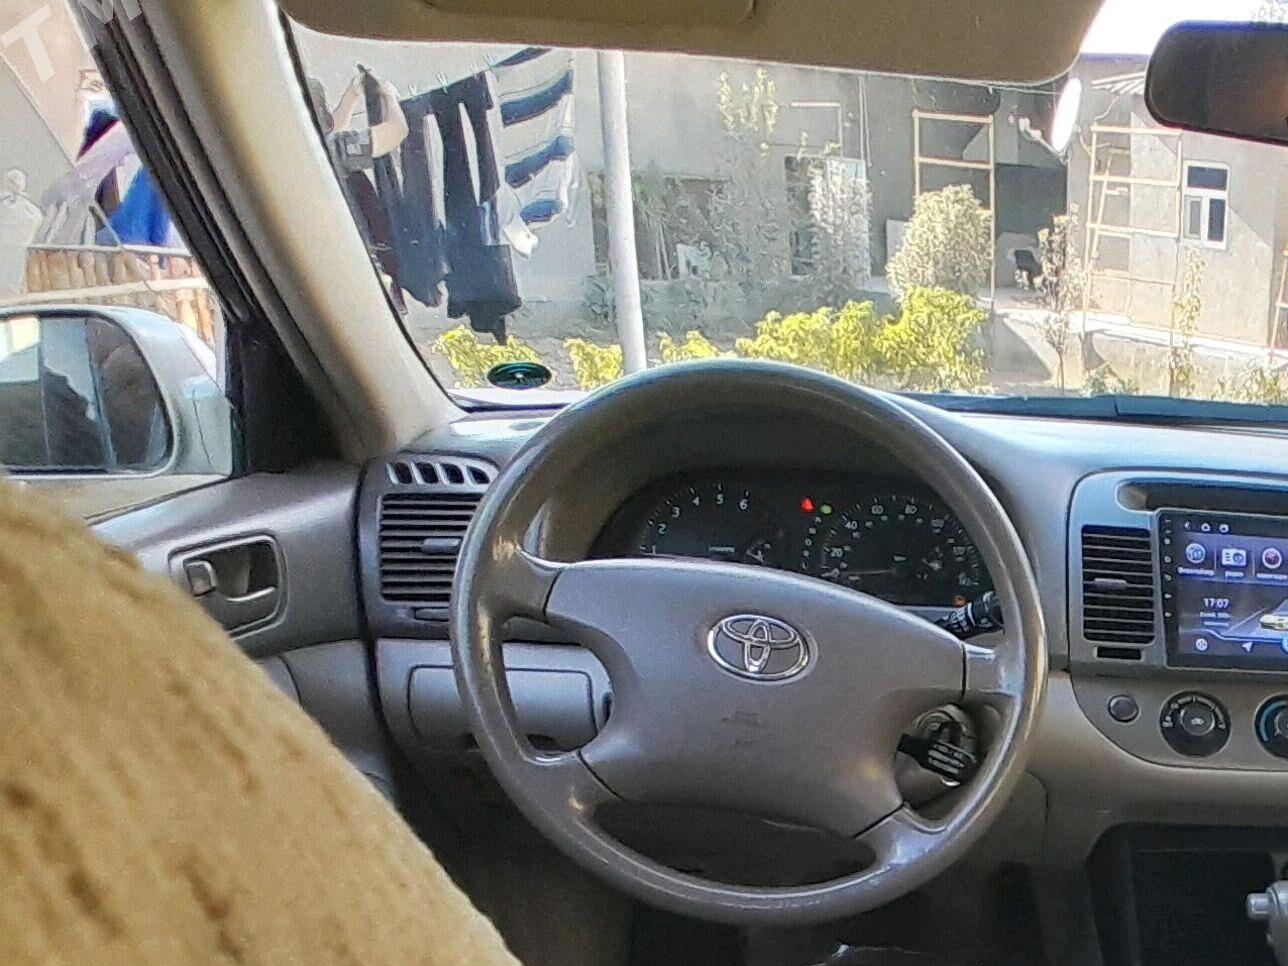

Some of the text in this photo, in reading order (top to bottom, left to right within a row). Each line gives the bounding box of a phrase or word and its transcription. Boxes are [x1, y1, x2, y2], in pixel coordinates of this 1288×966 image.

[691, 496, 700, 507] 4
[715, 493, 724, 505] 5
[739, 498, 748, 511] 6
[672, 506, 681, 519] 3
[658, 522, 668, 535] 2
[845, 520, 858, 530] 40
